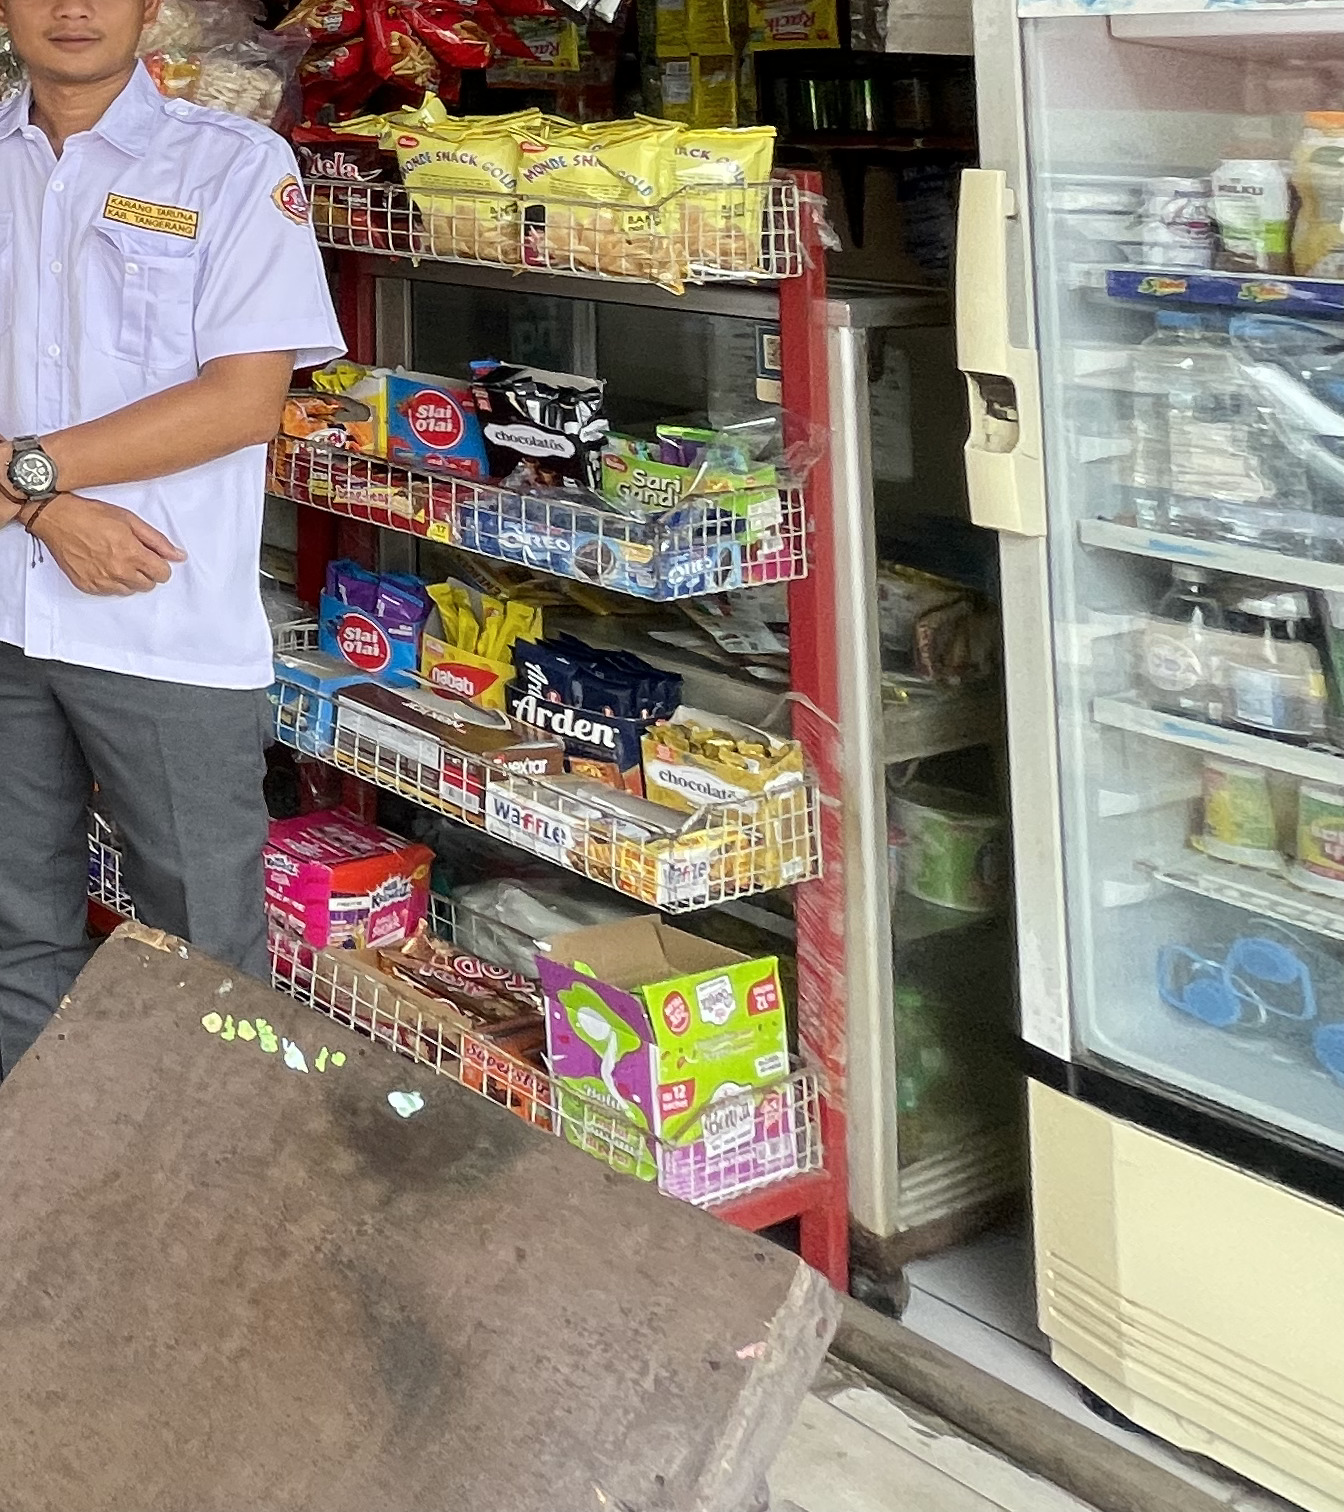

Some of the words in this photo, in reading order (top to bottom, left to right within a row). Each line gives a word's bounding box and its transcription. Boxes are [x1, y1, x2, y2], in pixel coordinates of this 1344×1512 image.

[436, 150, 479, 166] SNACK
[481, 161, 518, 191] GOLD
[522, 155, 568, 183] MONDE
[110, 197, 152, 213] KARANG
[156, 208, 194, 222] TARUNA
[133, 214, 193, 234] TANGERANG
[416, 403, 452, 419] Slai
[631, 469, 682, 490] Sari
[343, 626, 379, 640] Slai
[431, 666, 475, 697] nabati
[512, 694, 620, 749] Arden
